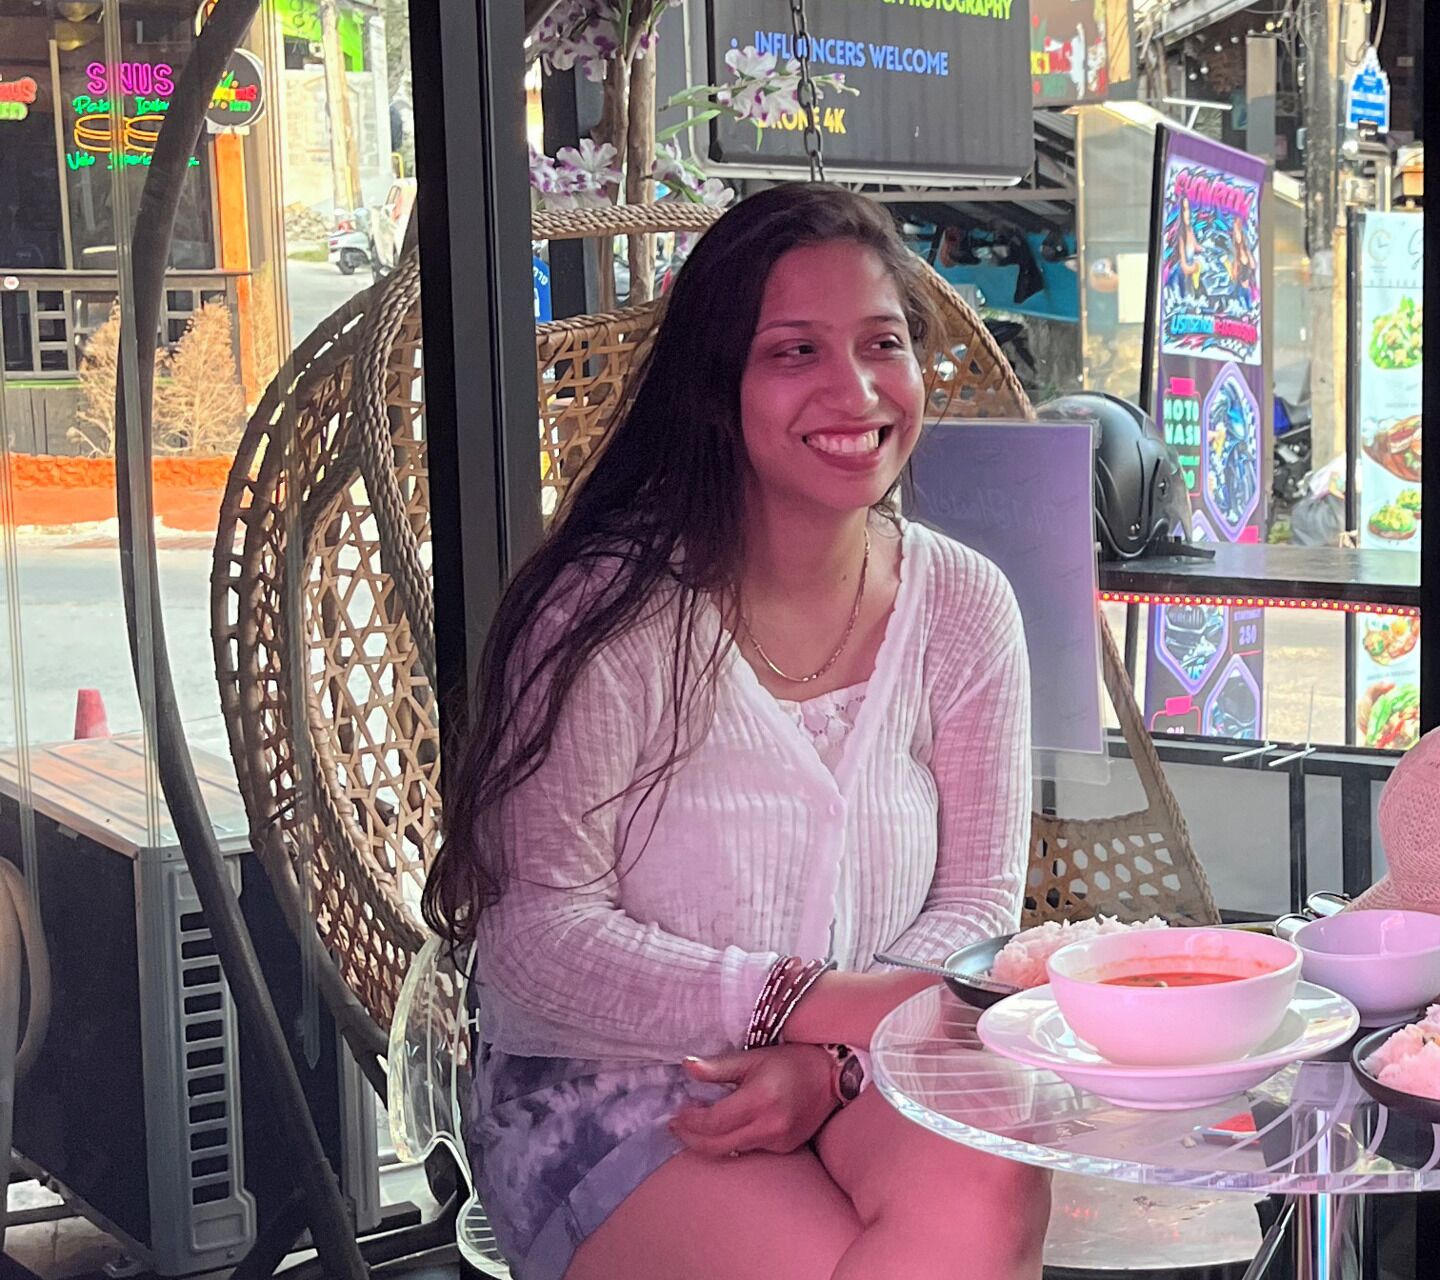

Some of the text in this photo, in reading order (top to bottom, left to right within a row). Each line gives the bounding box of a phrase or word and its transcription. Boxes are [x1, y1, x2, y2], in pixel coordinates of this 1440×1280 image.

[869, 43, 949, 76] WELCOME
[85, 61, 175, 96] SNUS
[823, 107, 847, 134] 4K
[1163, 399, 1200, 423] MOTO
